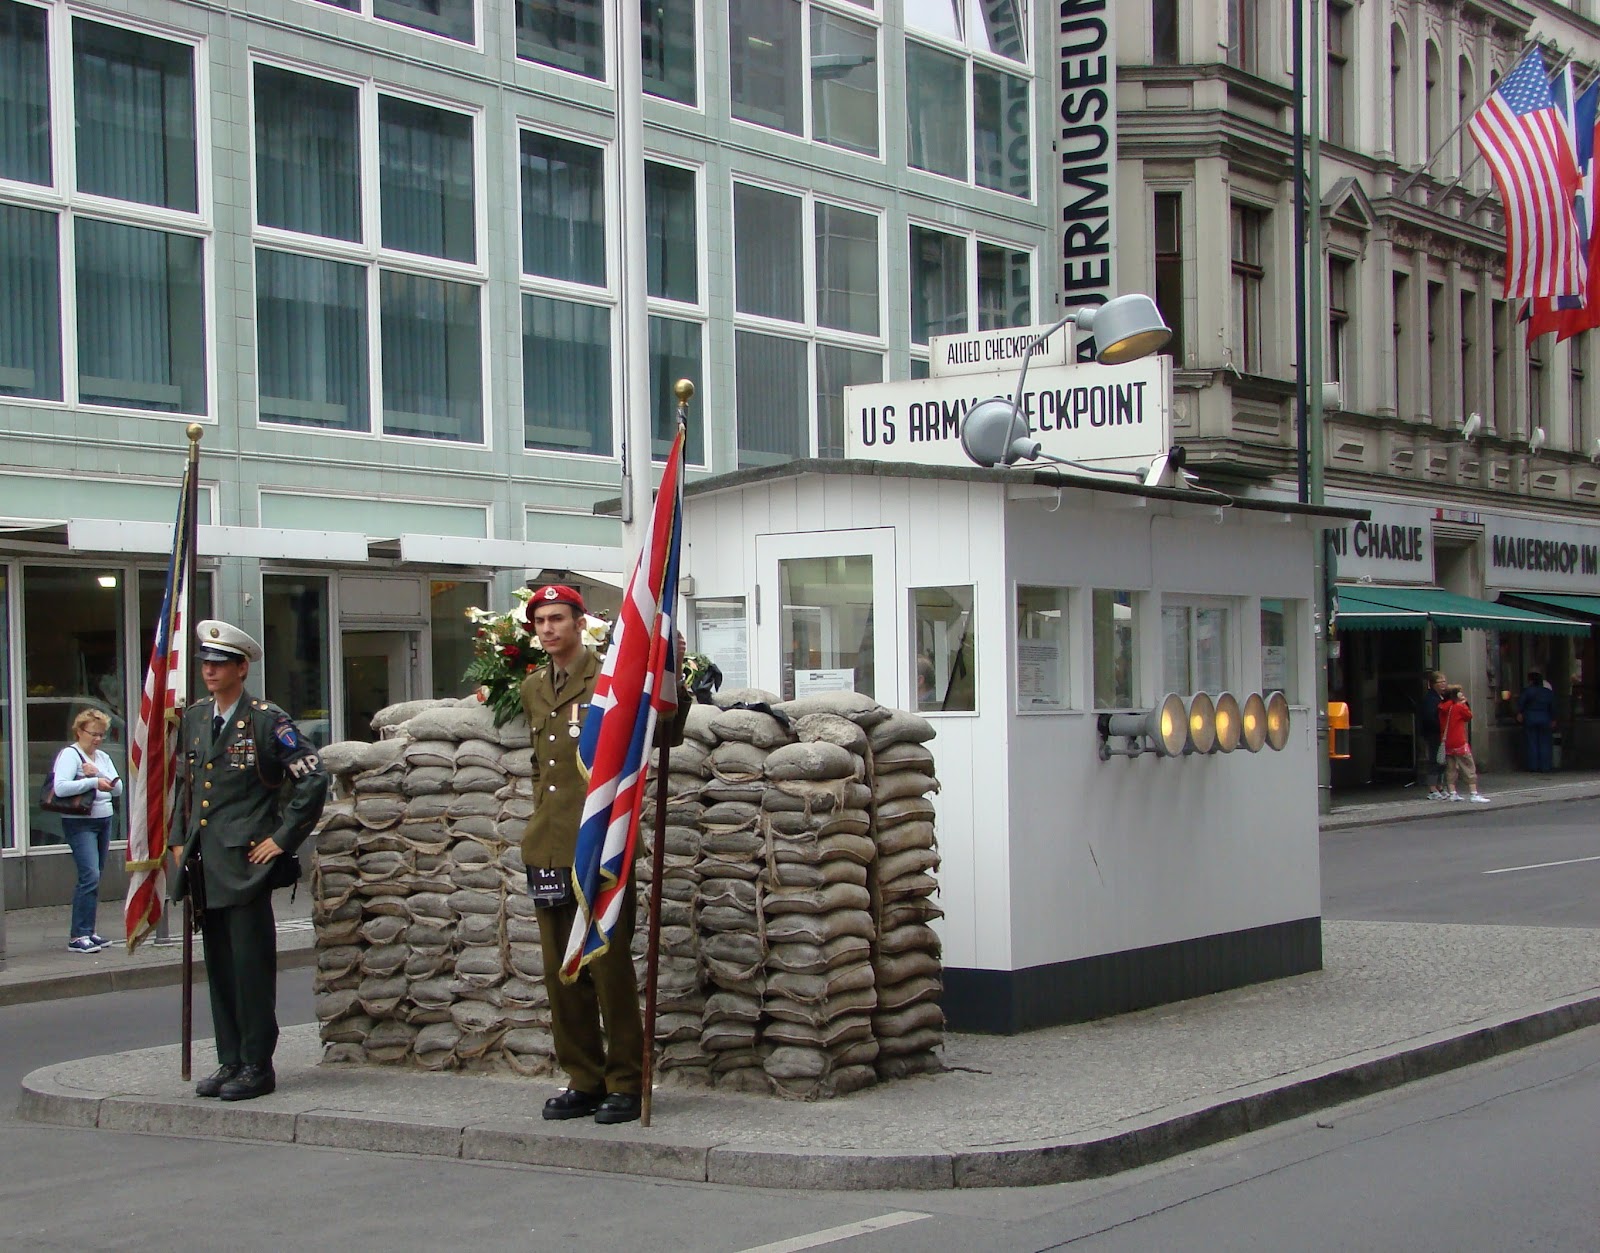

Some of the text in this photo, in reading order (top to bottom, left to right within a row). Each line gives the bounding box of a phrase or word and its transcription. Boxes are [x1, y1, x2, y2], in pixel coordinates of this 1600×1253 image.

[947, 340, 980, 365] ALLIED
[993, 381, 1147, 432] ECKPOINT
[1353, 521, 1423, 562] CHARLIE
[1493, 534, 1598, 575] MAUERSHOP IM
[289, 754, 319, 779] MP
